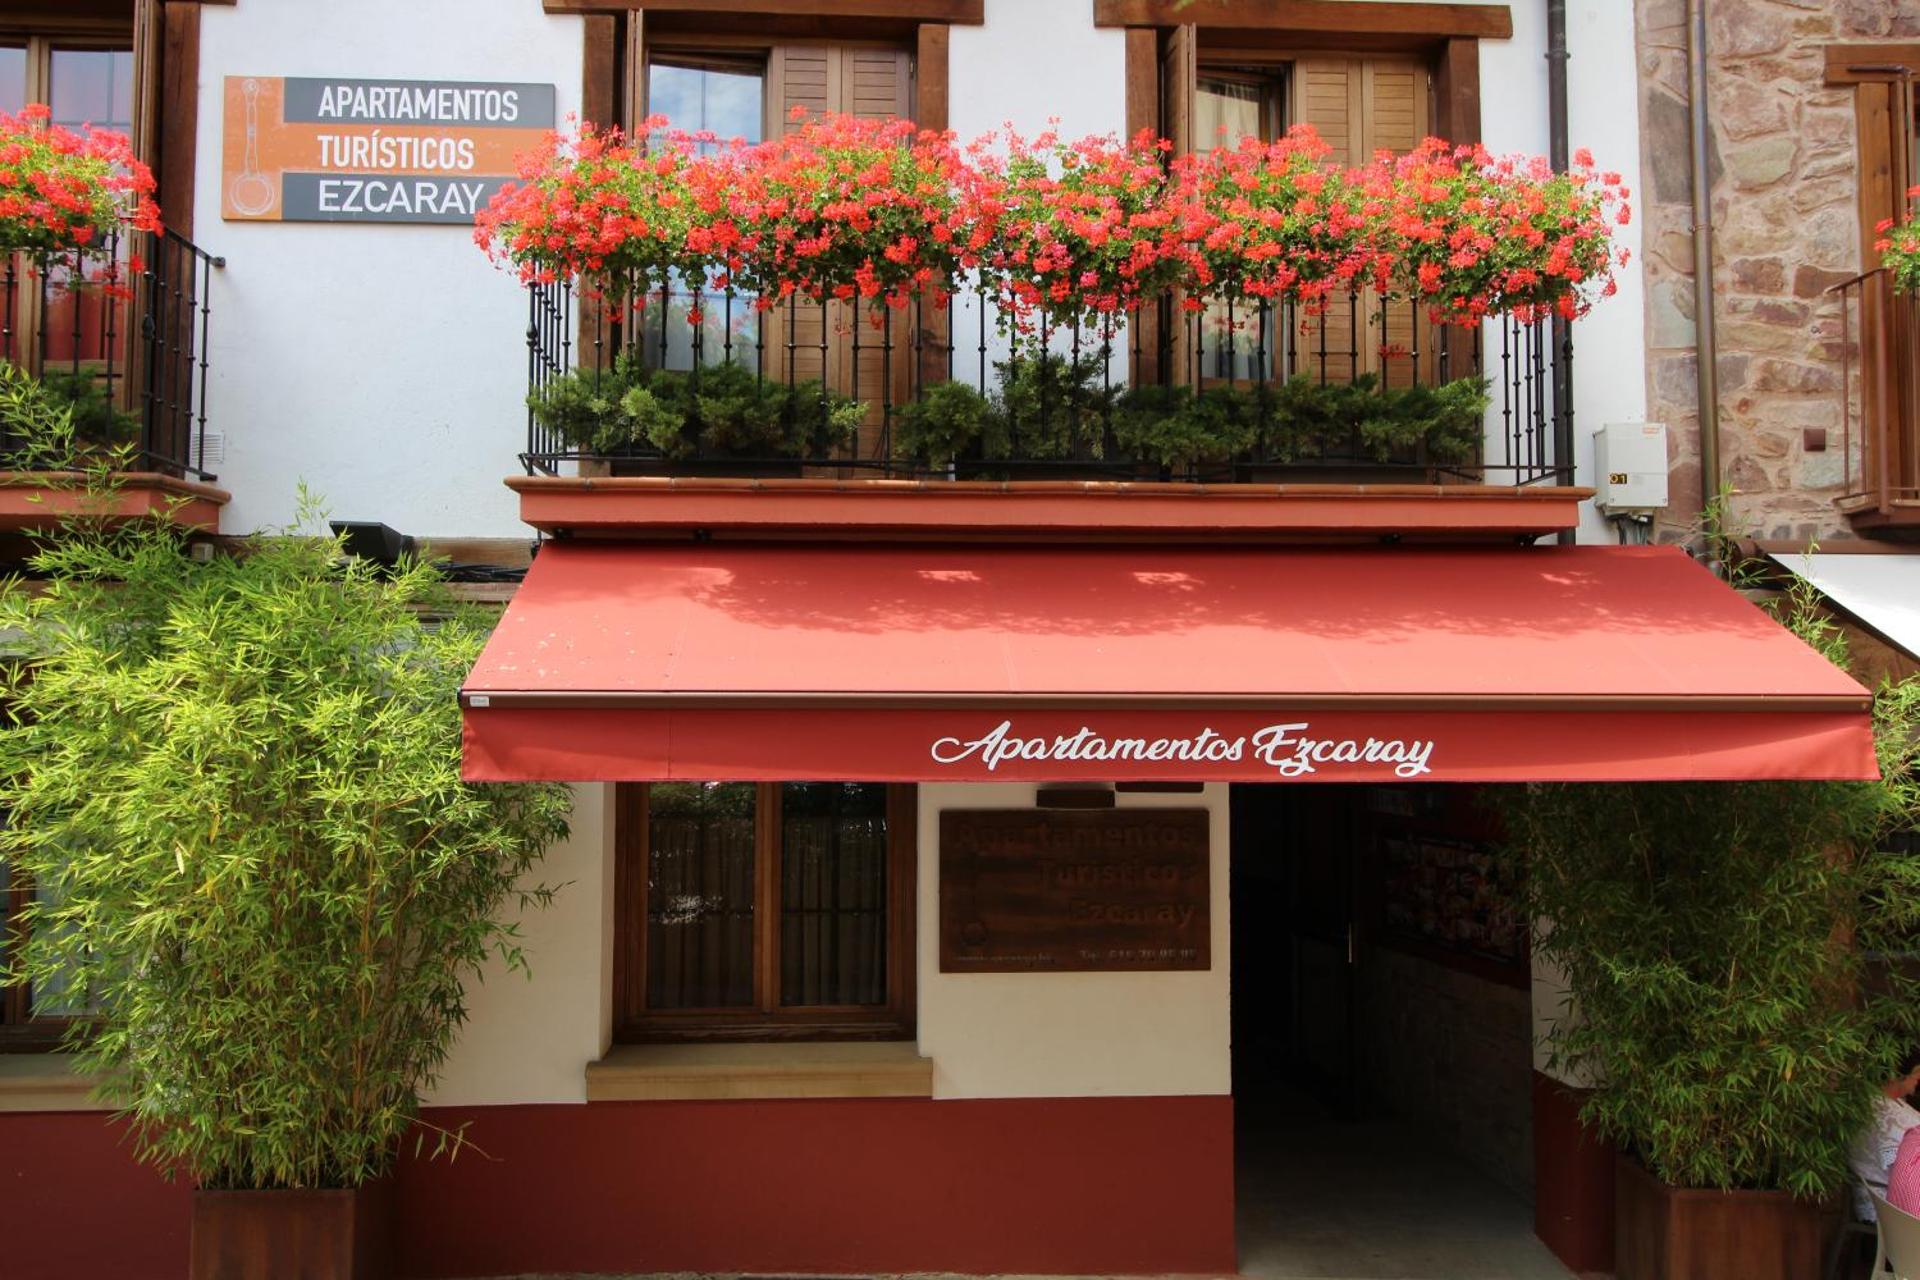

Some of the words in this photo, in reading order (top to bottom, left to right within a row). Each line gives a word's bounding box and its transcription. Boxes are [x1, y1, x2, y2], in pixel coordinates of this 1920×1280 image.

[318, 86, 518, 121] APARTAMENTOS
[317, 130, 475, 170] TURÍSTICOS
[319, 180, 484, 214] EZCARAY
[931, 720, 1244, 770] Apartamentos
[1252, 722, 1434, 777] Ezcaray
